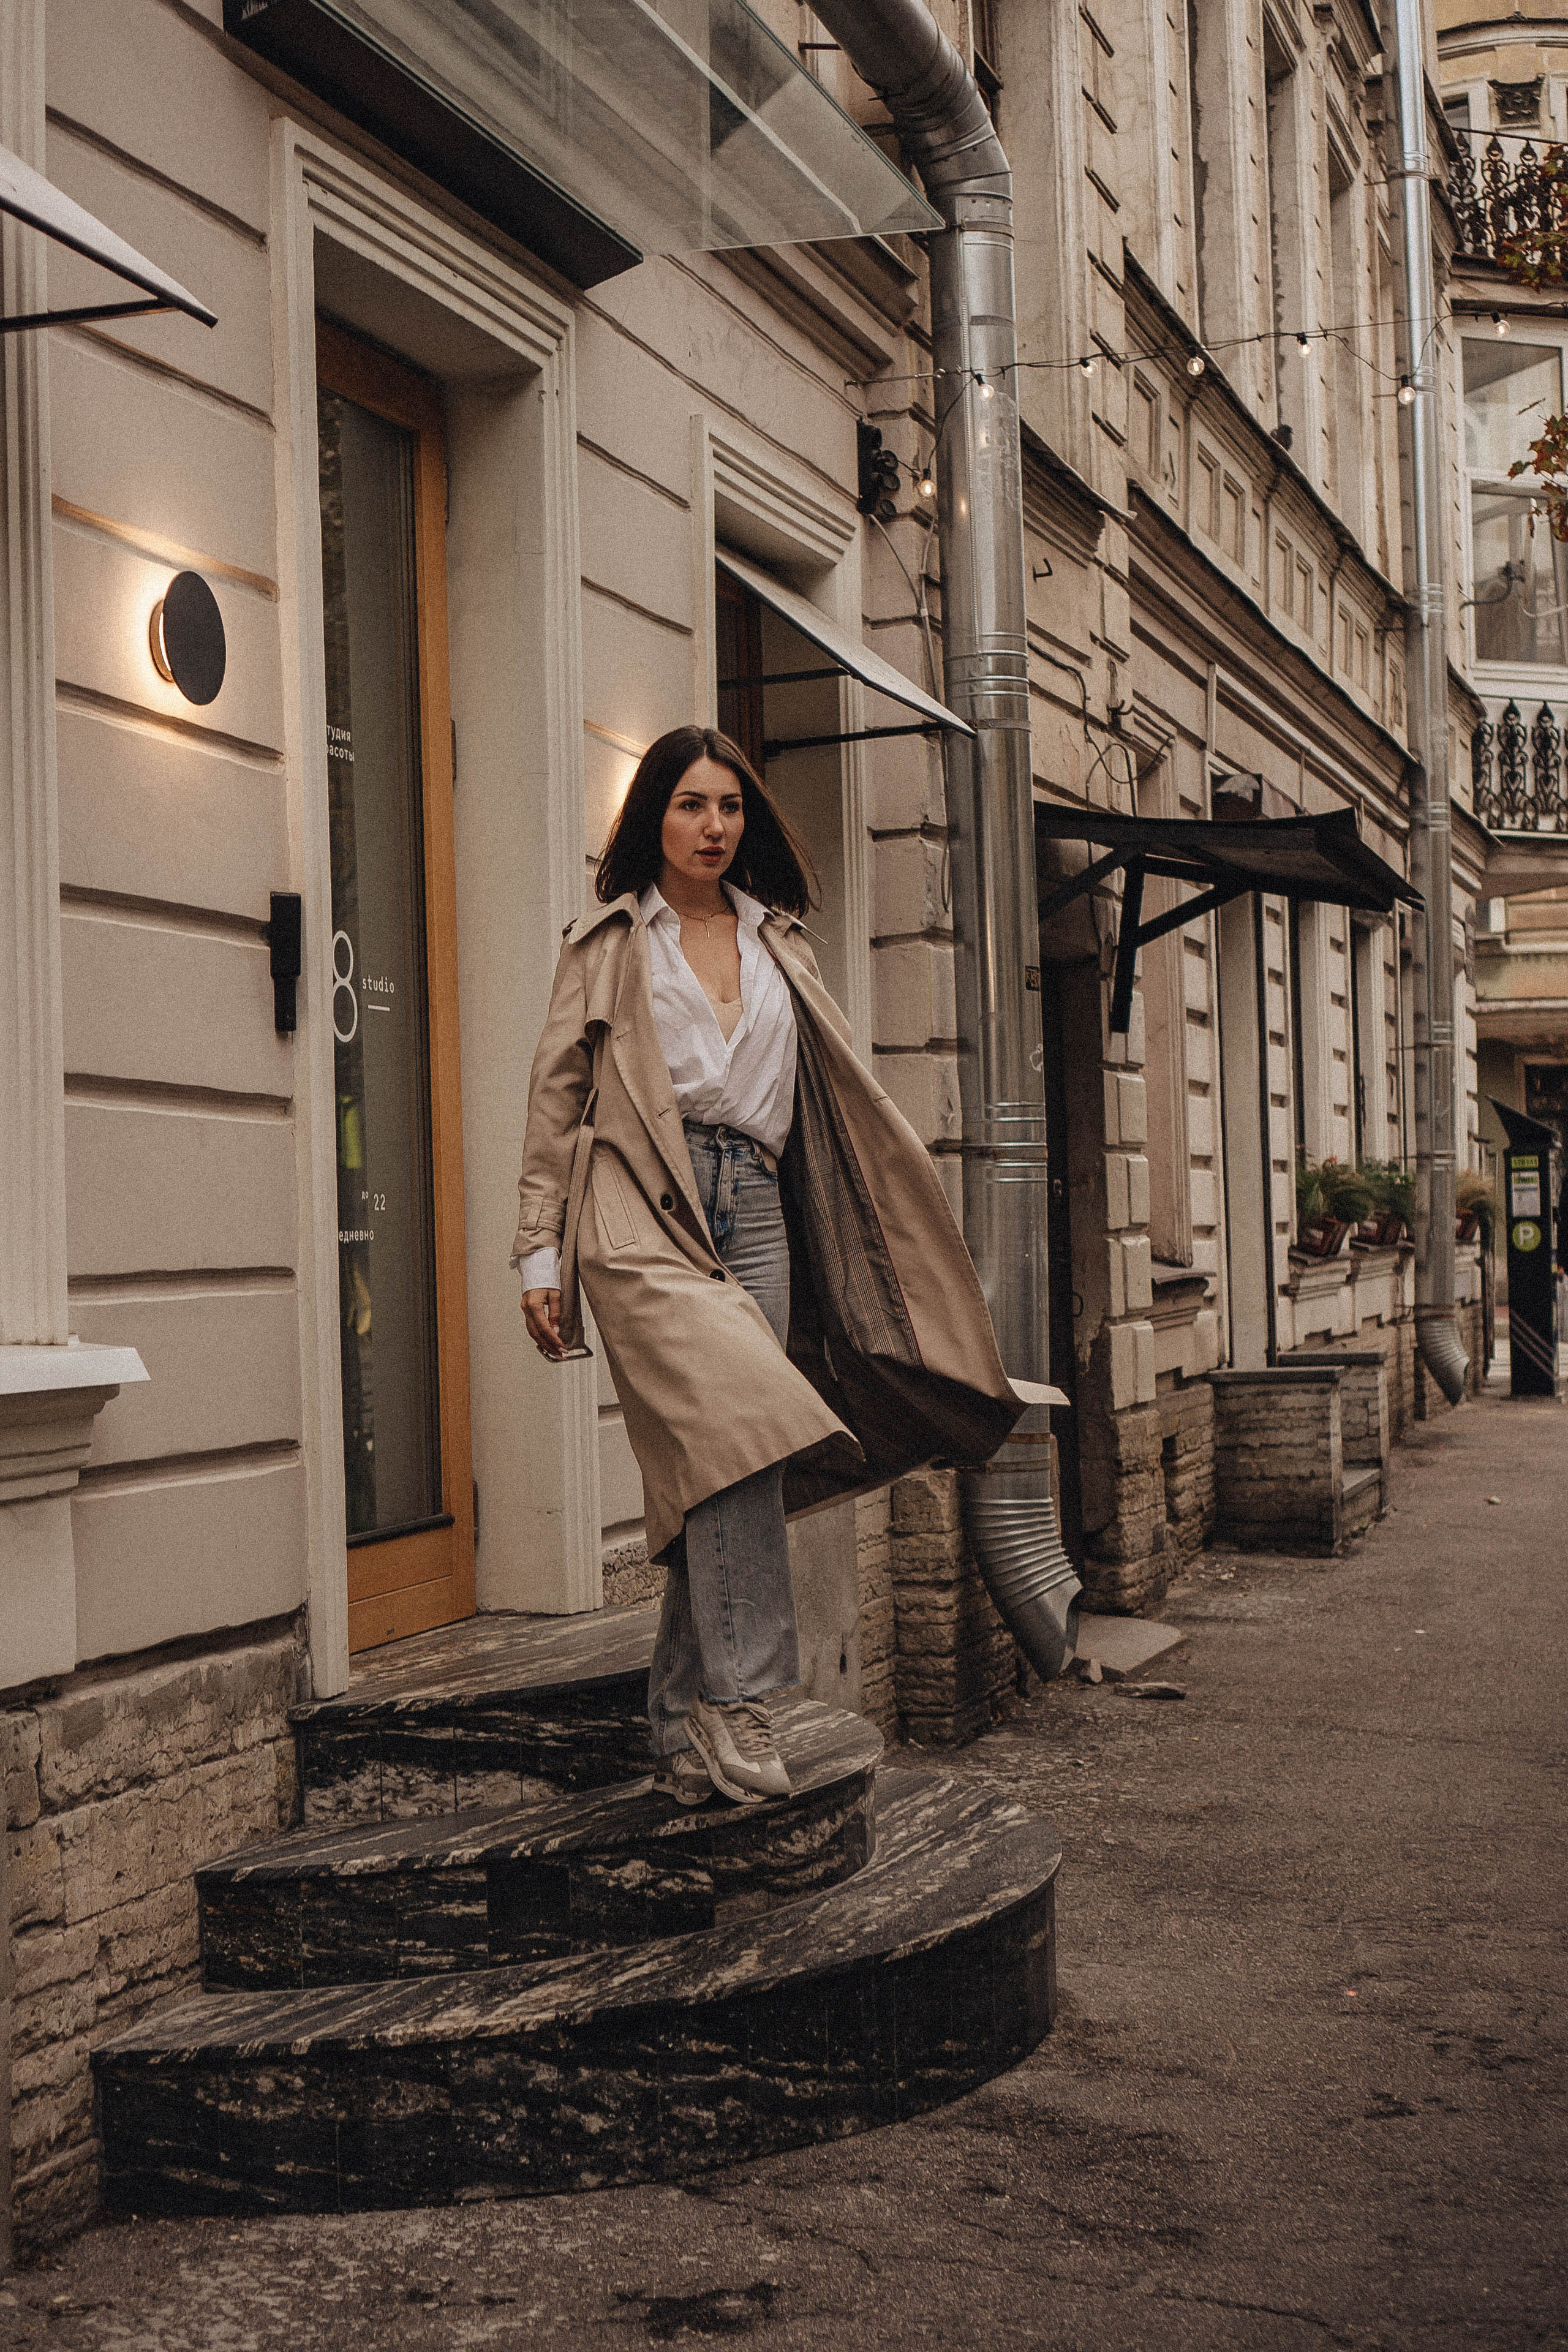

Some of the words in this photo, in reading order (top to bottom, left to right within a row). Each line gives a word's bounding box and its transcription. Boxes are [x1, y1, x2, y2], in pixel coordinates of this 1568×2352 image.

[326, 744, 355, 762] асоты
[333, 930, 358, 1042] 8
[362, 974, 394, 993] studio
[361, 1191, 369, 1200] до
[374, 1193, 386, 1211] 22
[339, 1230, 374, 1244] едневно
[1519, 1226, 1534, 1245] P
